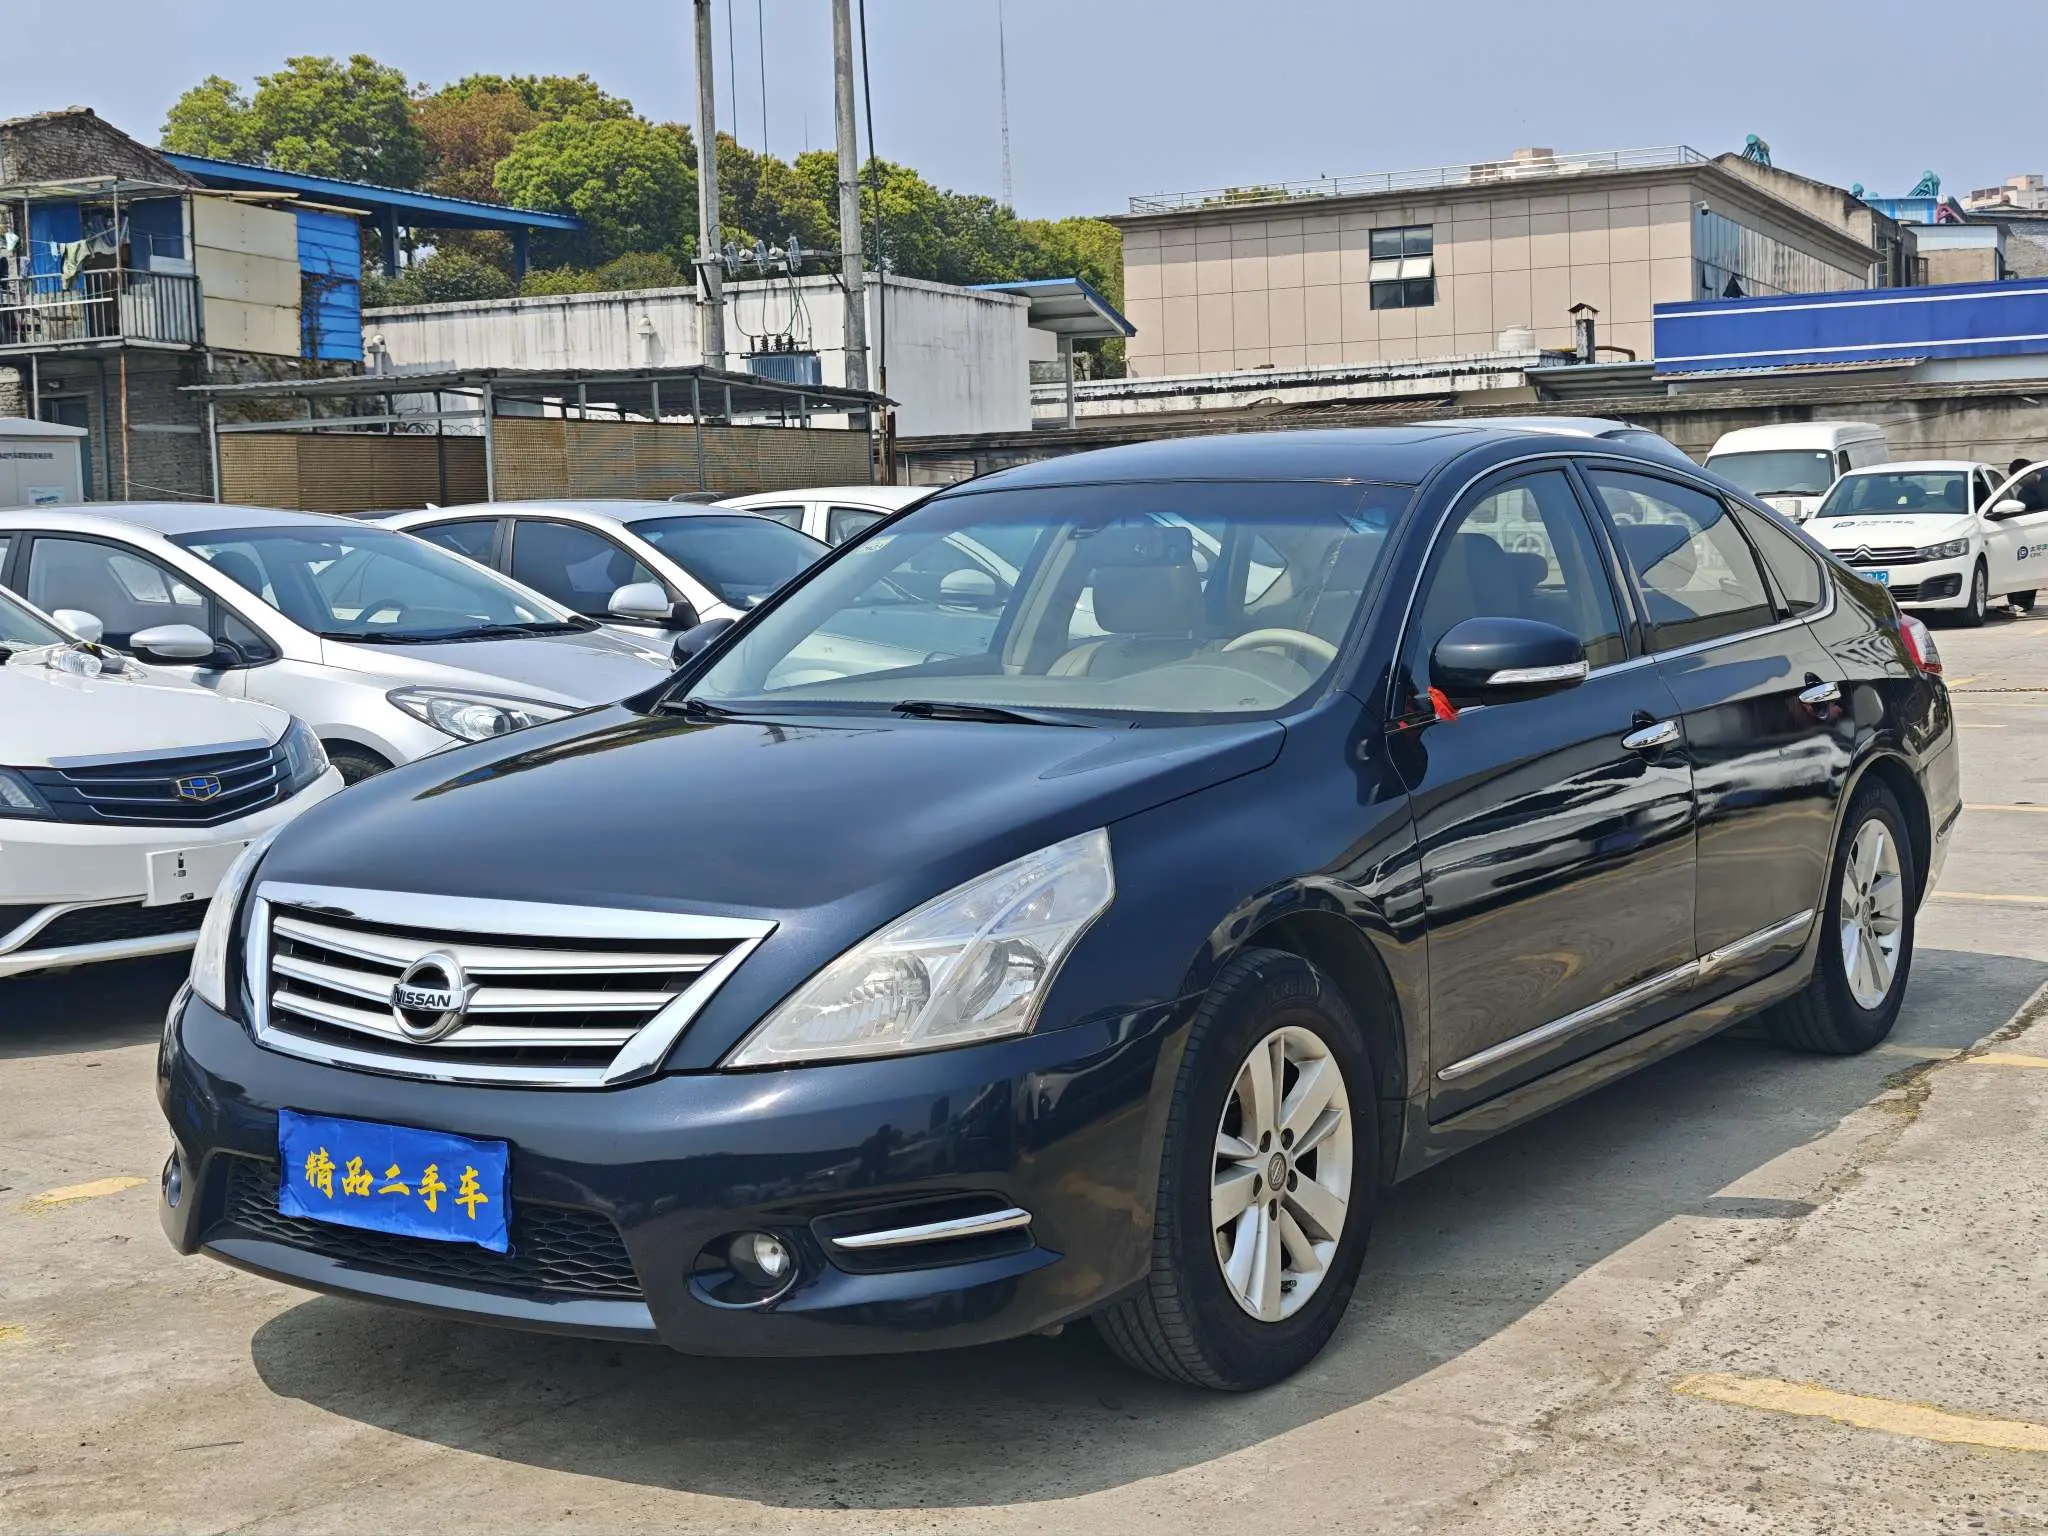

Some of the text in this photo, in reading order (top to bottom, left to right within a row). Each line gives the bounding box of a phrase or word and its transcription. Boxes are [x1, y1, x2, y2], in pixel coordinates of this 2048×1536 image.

[394, 985, 451, 1007] NISSAN
[304, 1147, 489, 1220] 精品二手车
